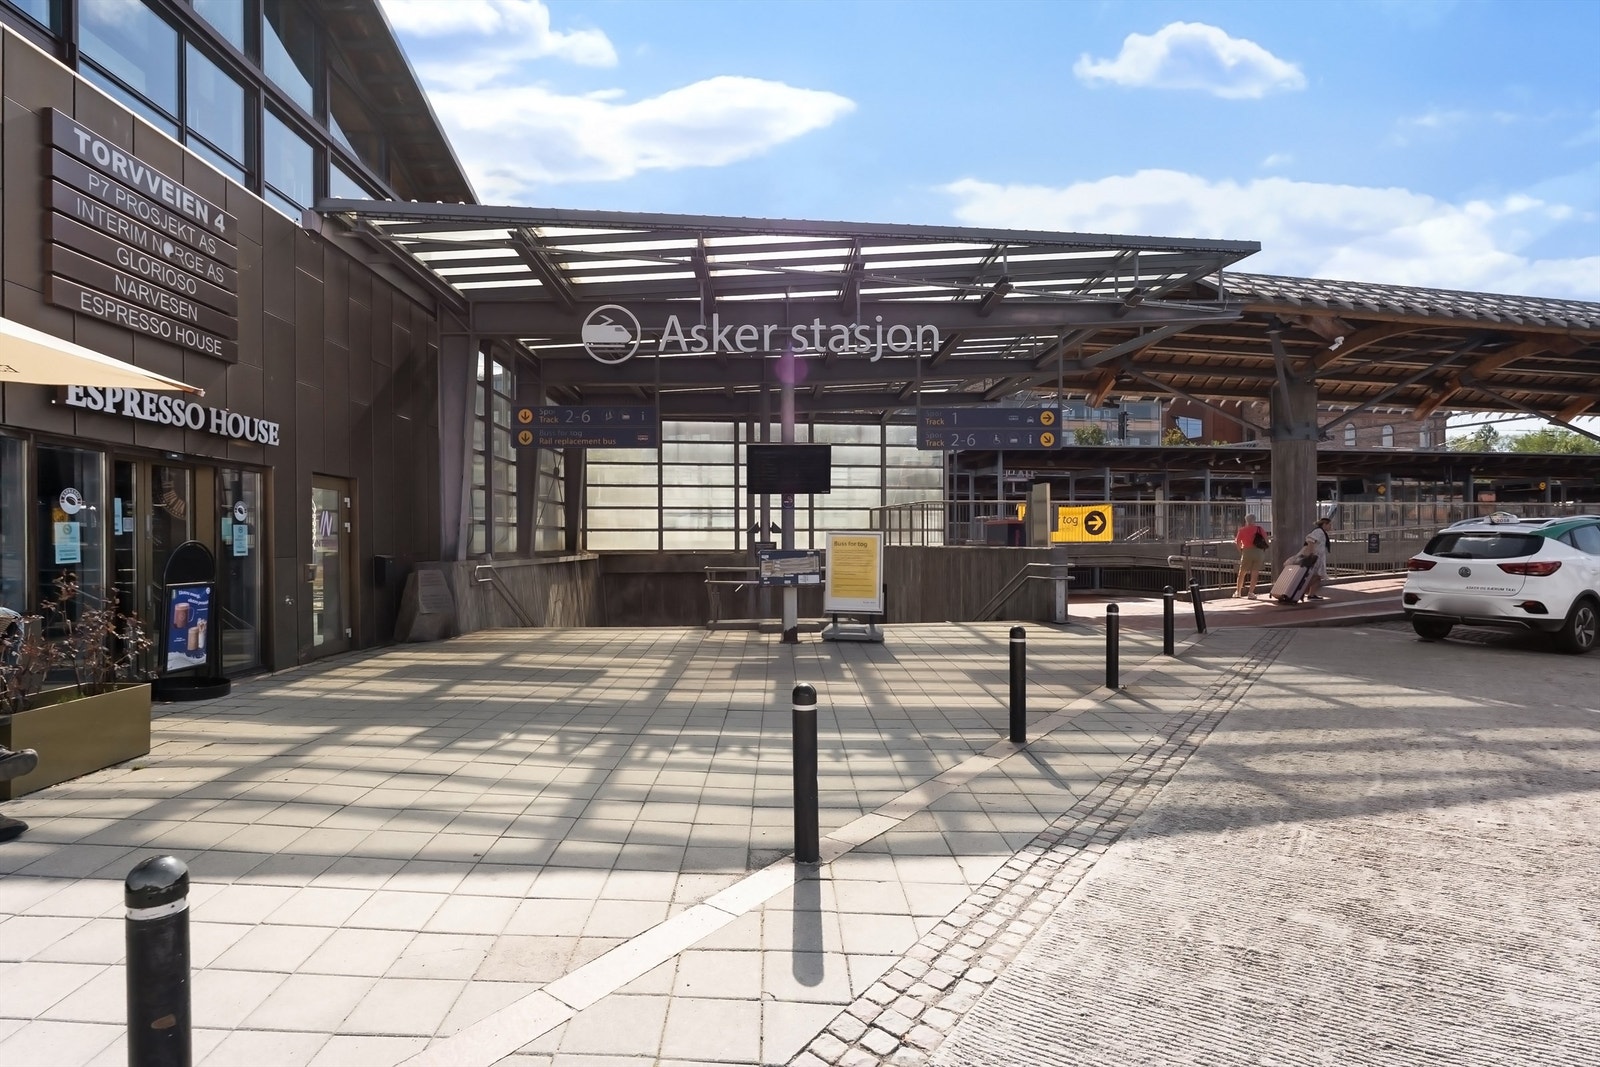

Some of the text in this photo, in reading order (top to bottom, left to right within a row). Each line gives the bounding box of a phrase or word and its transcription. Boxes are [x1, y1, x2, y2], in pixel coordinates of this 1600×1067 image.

[73, 127, 225, 233] TORVVEIEN 4
[88, 173, 217, 255] P7 PROSJEKT AS
[76, 197, 147, 247] INTERIM
[207, 265, 225, 283] AS
[116, 246, 197, 295] GLORIOSO
[115, 274, 198, 322] NARVESEN
[80, 291, 223, 356] ESPRESSO HOUSE
[657, 313, 940, 362] Asker stasjon
[65, 384, 280, 447] ESPRESSO HOUSE
[539, 409, 591, 424] Track 2-6
[925, 412, 958, 425] Track 1
[539, 437, 617, 446] Rail replacement bus
[925, 433, 976, 447] Track 2-6
[857, 540, 868, 549] tog
[1062, 515, 1079, 527] tog
